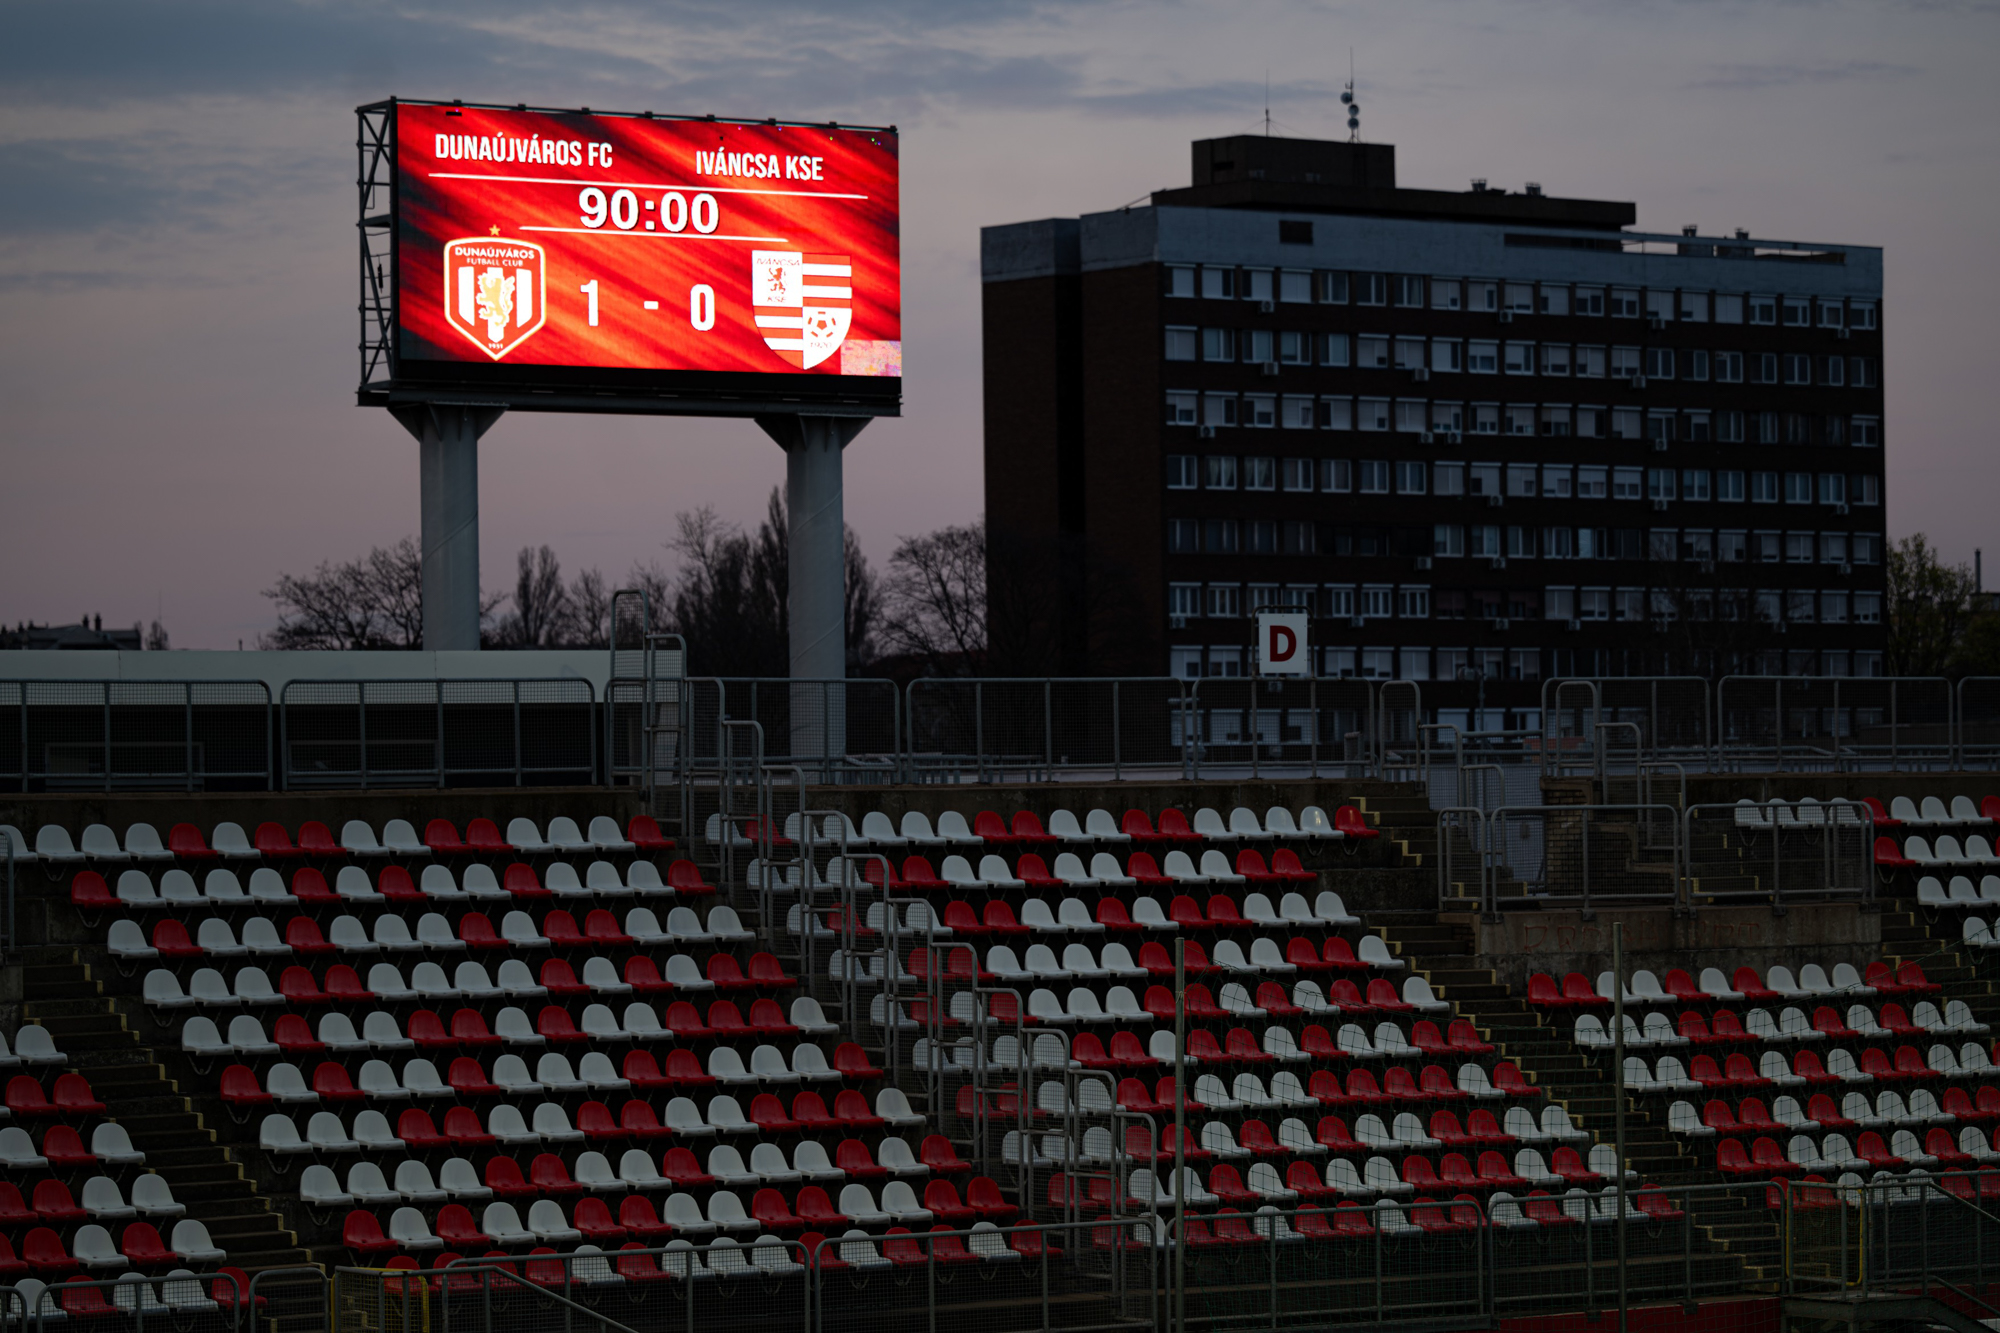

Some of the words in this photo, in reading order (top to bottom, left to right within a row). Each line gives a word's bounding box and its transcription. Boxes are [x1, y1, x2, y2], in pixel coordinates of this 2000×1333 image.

[435, 132, 582, 166] DUNAÚJVÁROS
[588, 143, 613, 168] FC
[696, 146, 781, 178] IVÁNCSA
[785, 155, 824, 181] KSE
[578, 187, 719, 234] 90:00
[455, 247, 535, 259] DUNAÚJVÁROS
[466, 257, 500, 266] FUTBALL
[502, 259, 524, 267] CLUB
[580, 279, 599, 327] 1
[690, 284, 715, 331] 0
[1270, 625, 1297, 662] D
